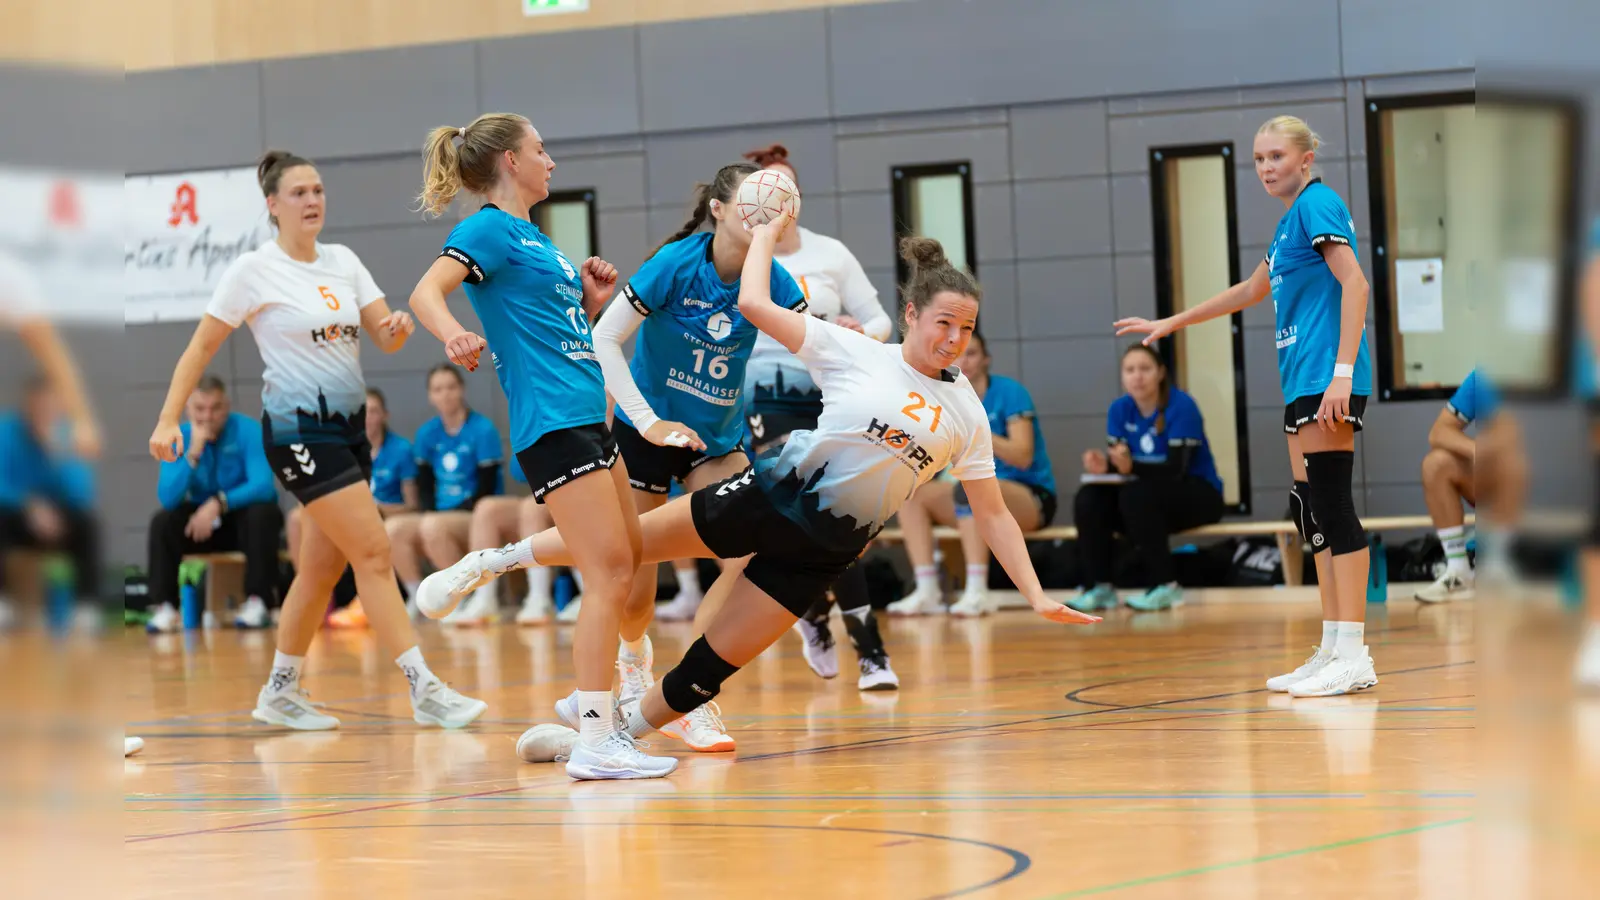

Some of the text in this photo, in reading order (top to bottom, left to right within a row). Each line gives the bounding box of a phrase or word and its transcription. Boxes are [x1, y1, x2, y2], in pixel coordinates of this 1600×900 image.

[447, 249, 470, 264] Kempa
[317, 286, 340, 311] 5
[683, 297, 713, 310] Kempa
[692, 348, 729, 380] 16
[901, 391, 942, 434] 21
[570, 461, 596, 476] Kempa
[546, 475, 567, 488] Kempa
